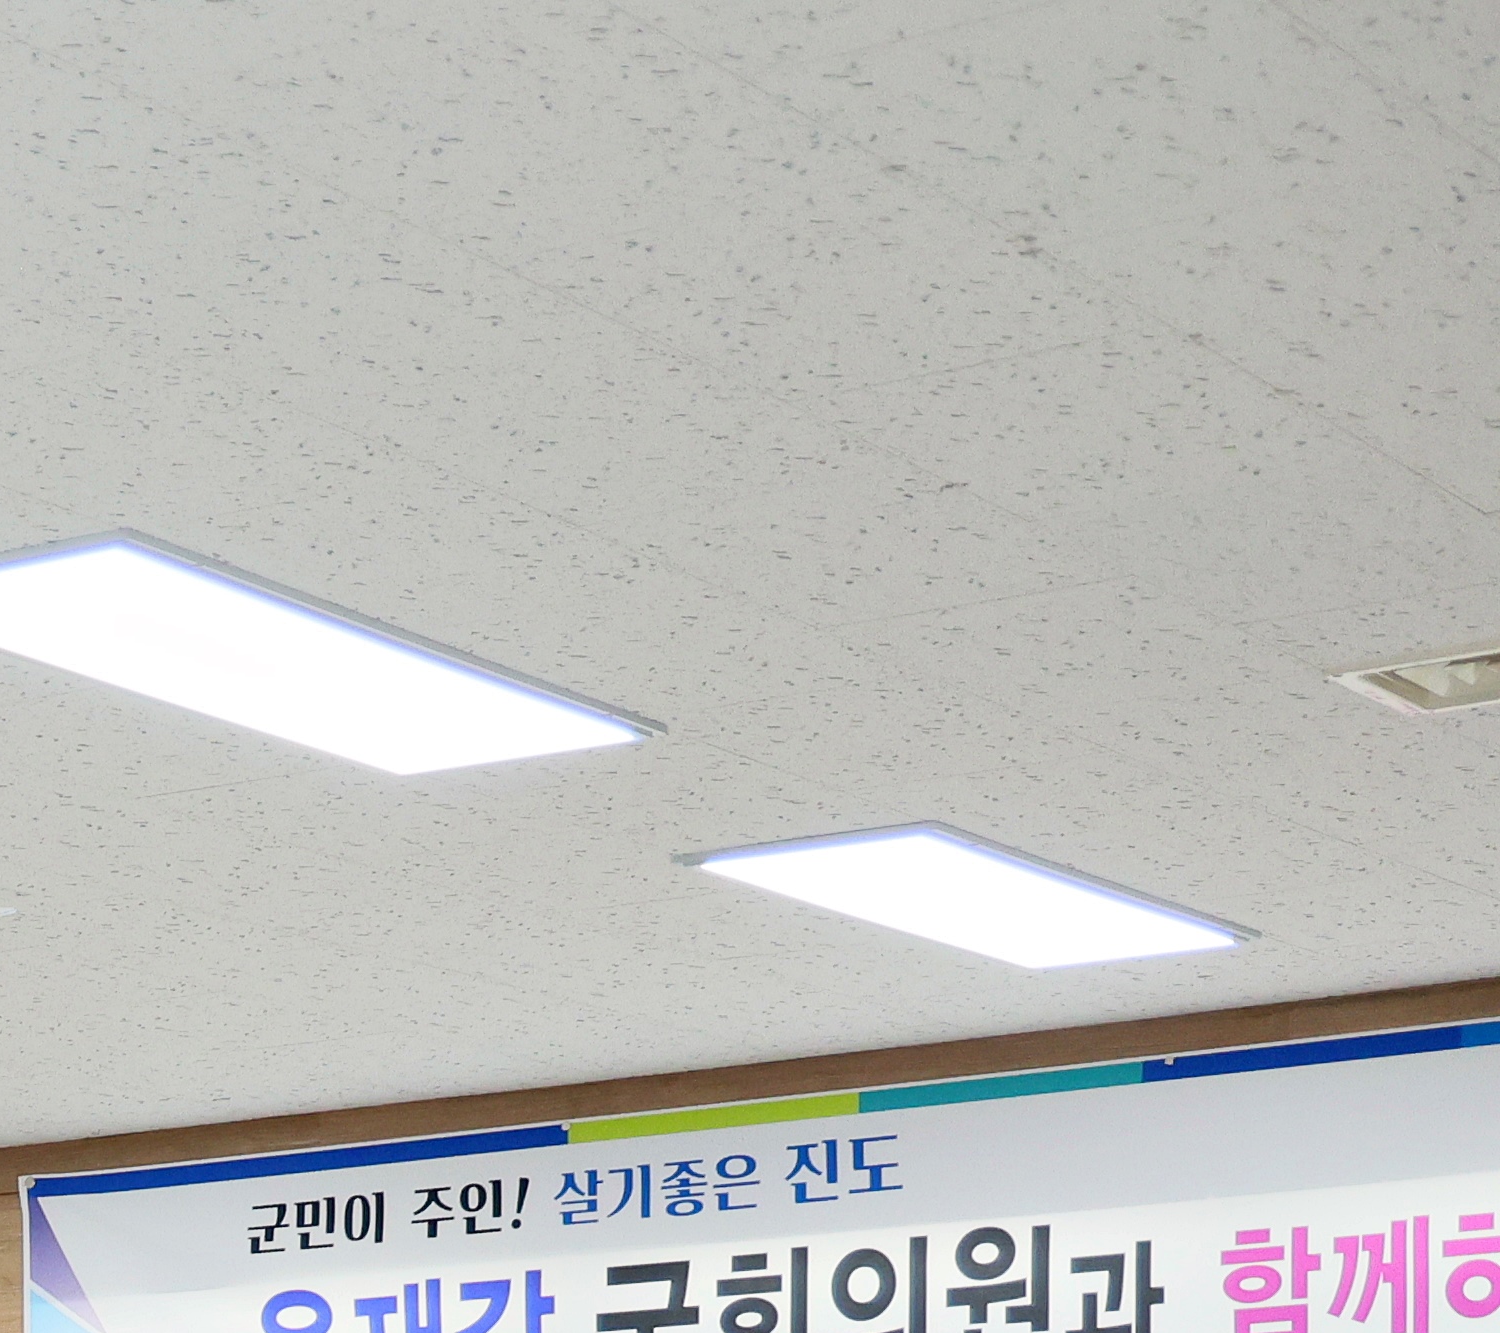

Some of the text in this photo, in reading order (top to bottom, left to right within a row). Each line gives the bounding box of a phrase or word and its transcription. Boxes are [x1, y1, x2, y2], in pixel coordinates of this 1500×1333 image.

[247, 1134, 904, 1254] 군민이 주인! 살기좋은 진도
